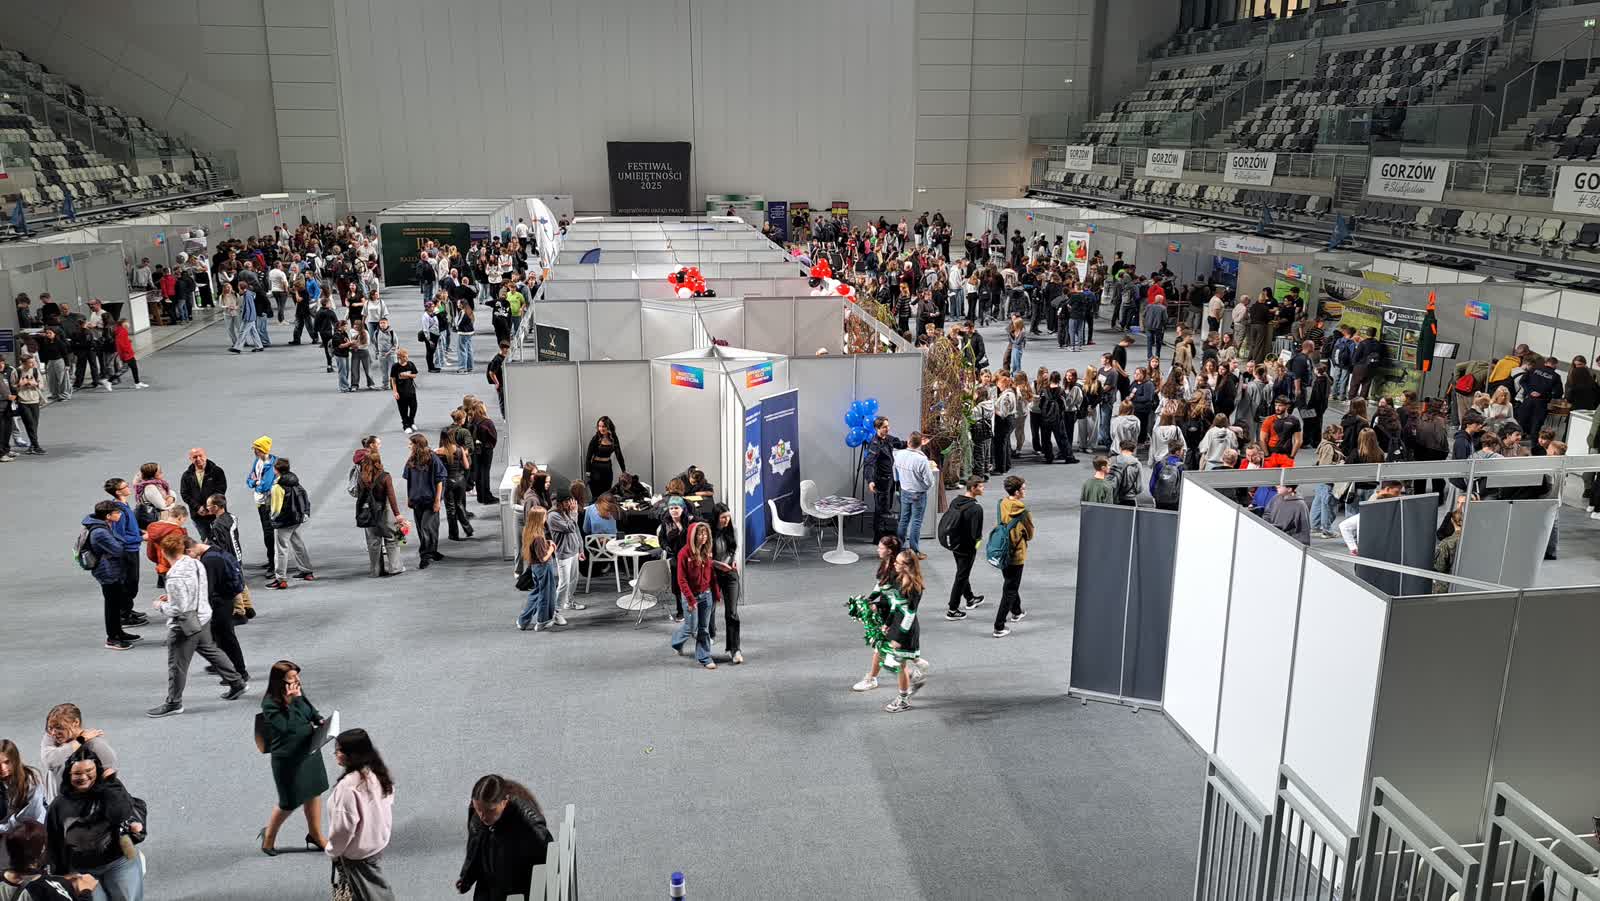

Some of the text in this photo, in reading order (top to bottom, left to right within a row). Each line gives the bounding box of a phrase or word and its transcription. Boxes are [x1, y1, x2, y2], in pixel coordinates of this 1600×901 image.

[1151, 151, 1179, 164] GORZÓW
[1232, 155, 1269, 170] GORZÓW
[627, 162, 672, 171] FESTIWAL
[1381, 161, 1437, 180] GORZÓW
[618, 170, 682, 182] UMIEJĘTNOŚCI
[640, 182, 662, 190] 2025
